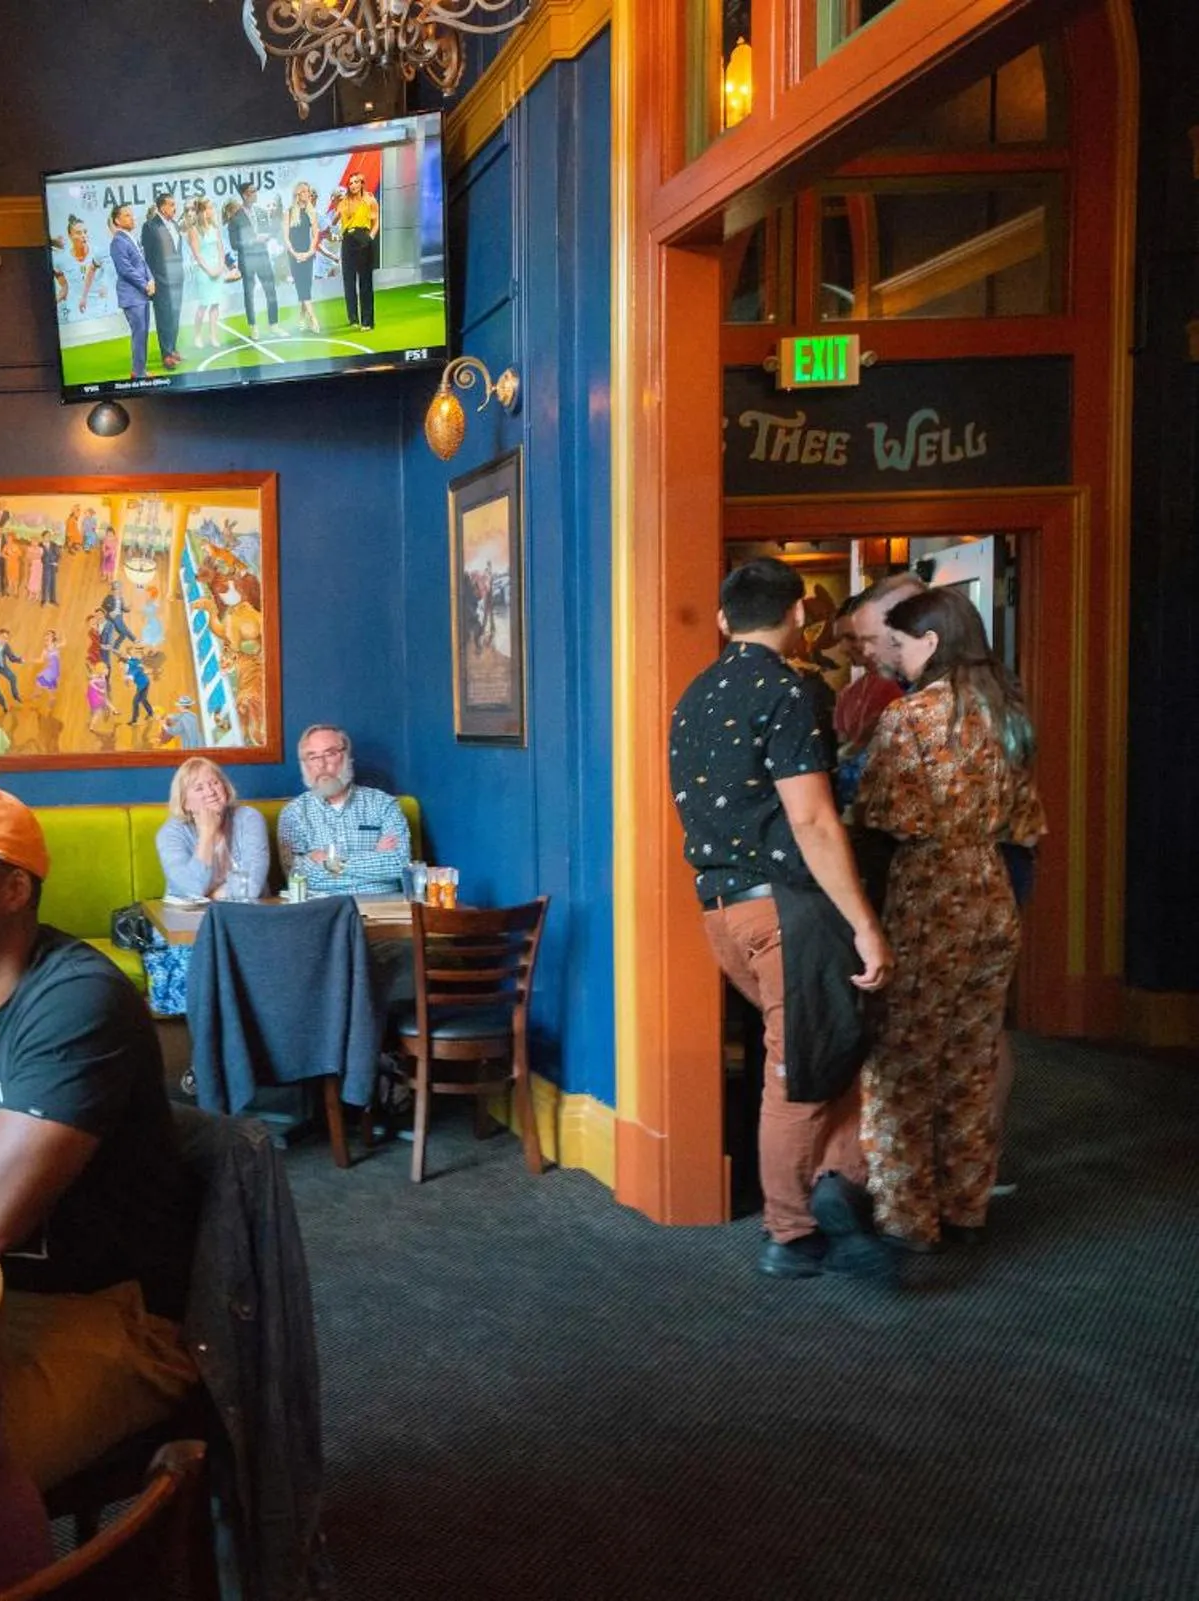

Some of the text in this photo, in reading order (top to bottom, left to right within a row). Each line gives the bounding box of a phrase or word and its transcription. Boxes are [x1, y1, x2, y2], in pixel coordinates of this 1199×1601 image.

[103, 184, 146, 208] ALL
[152, 178, 207, 201] EYES
[213, 173, 242, 197] ON
[250, 170, 276, 192] US
[405, 349, 428, 361] FS1
[793, 335, 849, 383] EXIT
